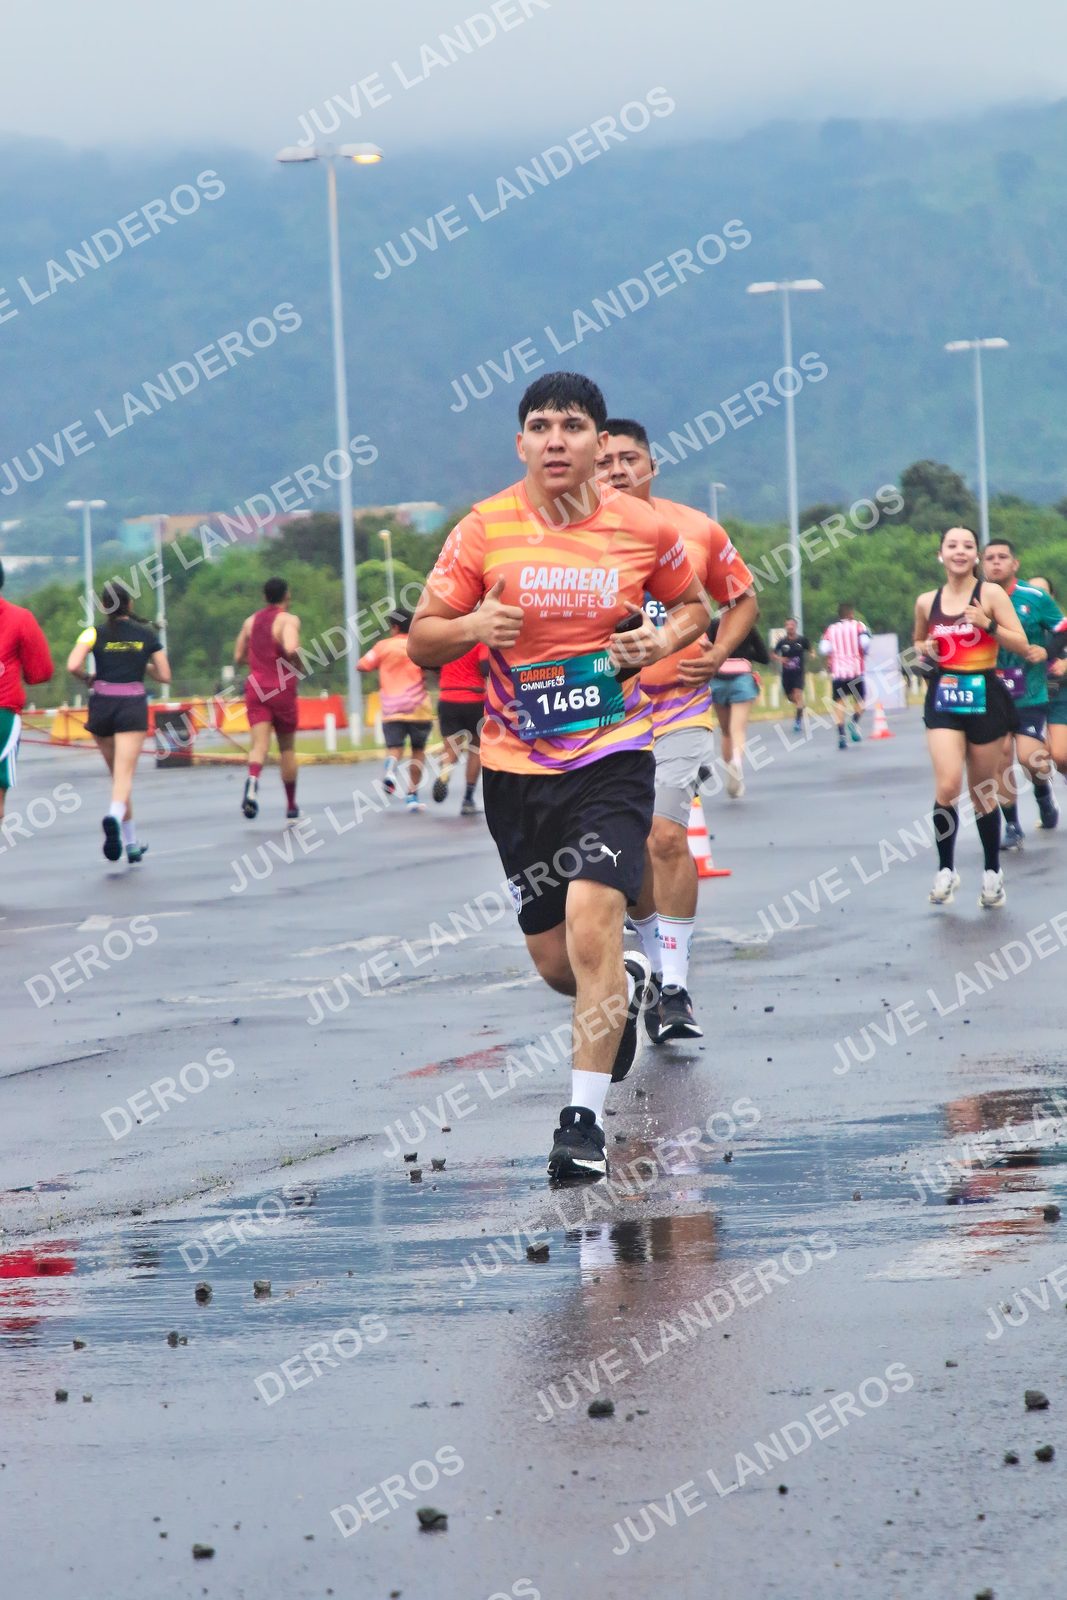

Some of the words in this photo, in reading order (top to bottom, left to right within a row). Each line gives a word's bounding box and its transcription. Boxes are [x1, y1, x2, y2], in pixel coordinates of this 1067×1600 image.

[520, 566, 619, 592] CARRERA
[519, 592, 597, 608] OMNILIFE
[593, 657, 611, 673] 10K
[519, 665, 564, 683] CARRERA
[520, 679, 556, 691] OMNILIFE
[536, 685, 601, 715] 1468
[943, 689, 974, 703] 1413
